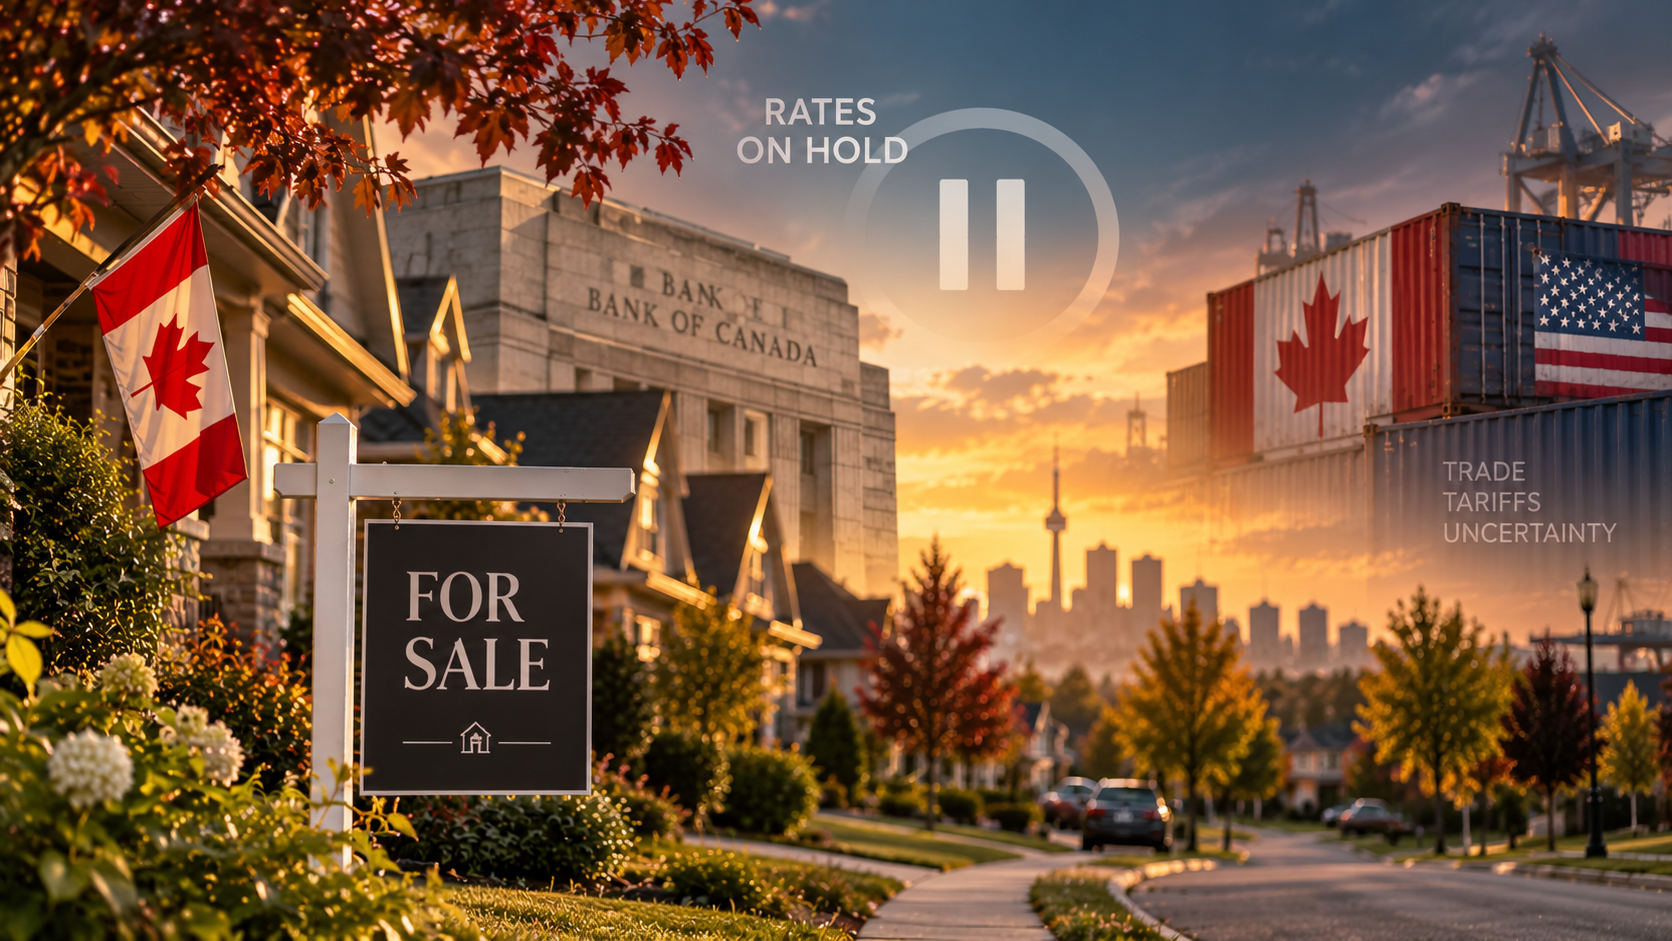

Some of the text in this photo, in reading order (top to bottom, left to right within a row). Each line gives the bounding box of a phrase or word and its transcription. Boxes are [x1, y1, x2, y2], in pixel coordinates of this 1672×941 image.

[662, 271, 723, 311] BANK
[588, 287, 817, 368] BANK OF CANADA
[406, 571, 525, 623] FOR
[404, 636, 550, 691] SALE
